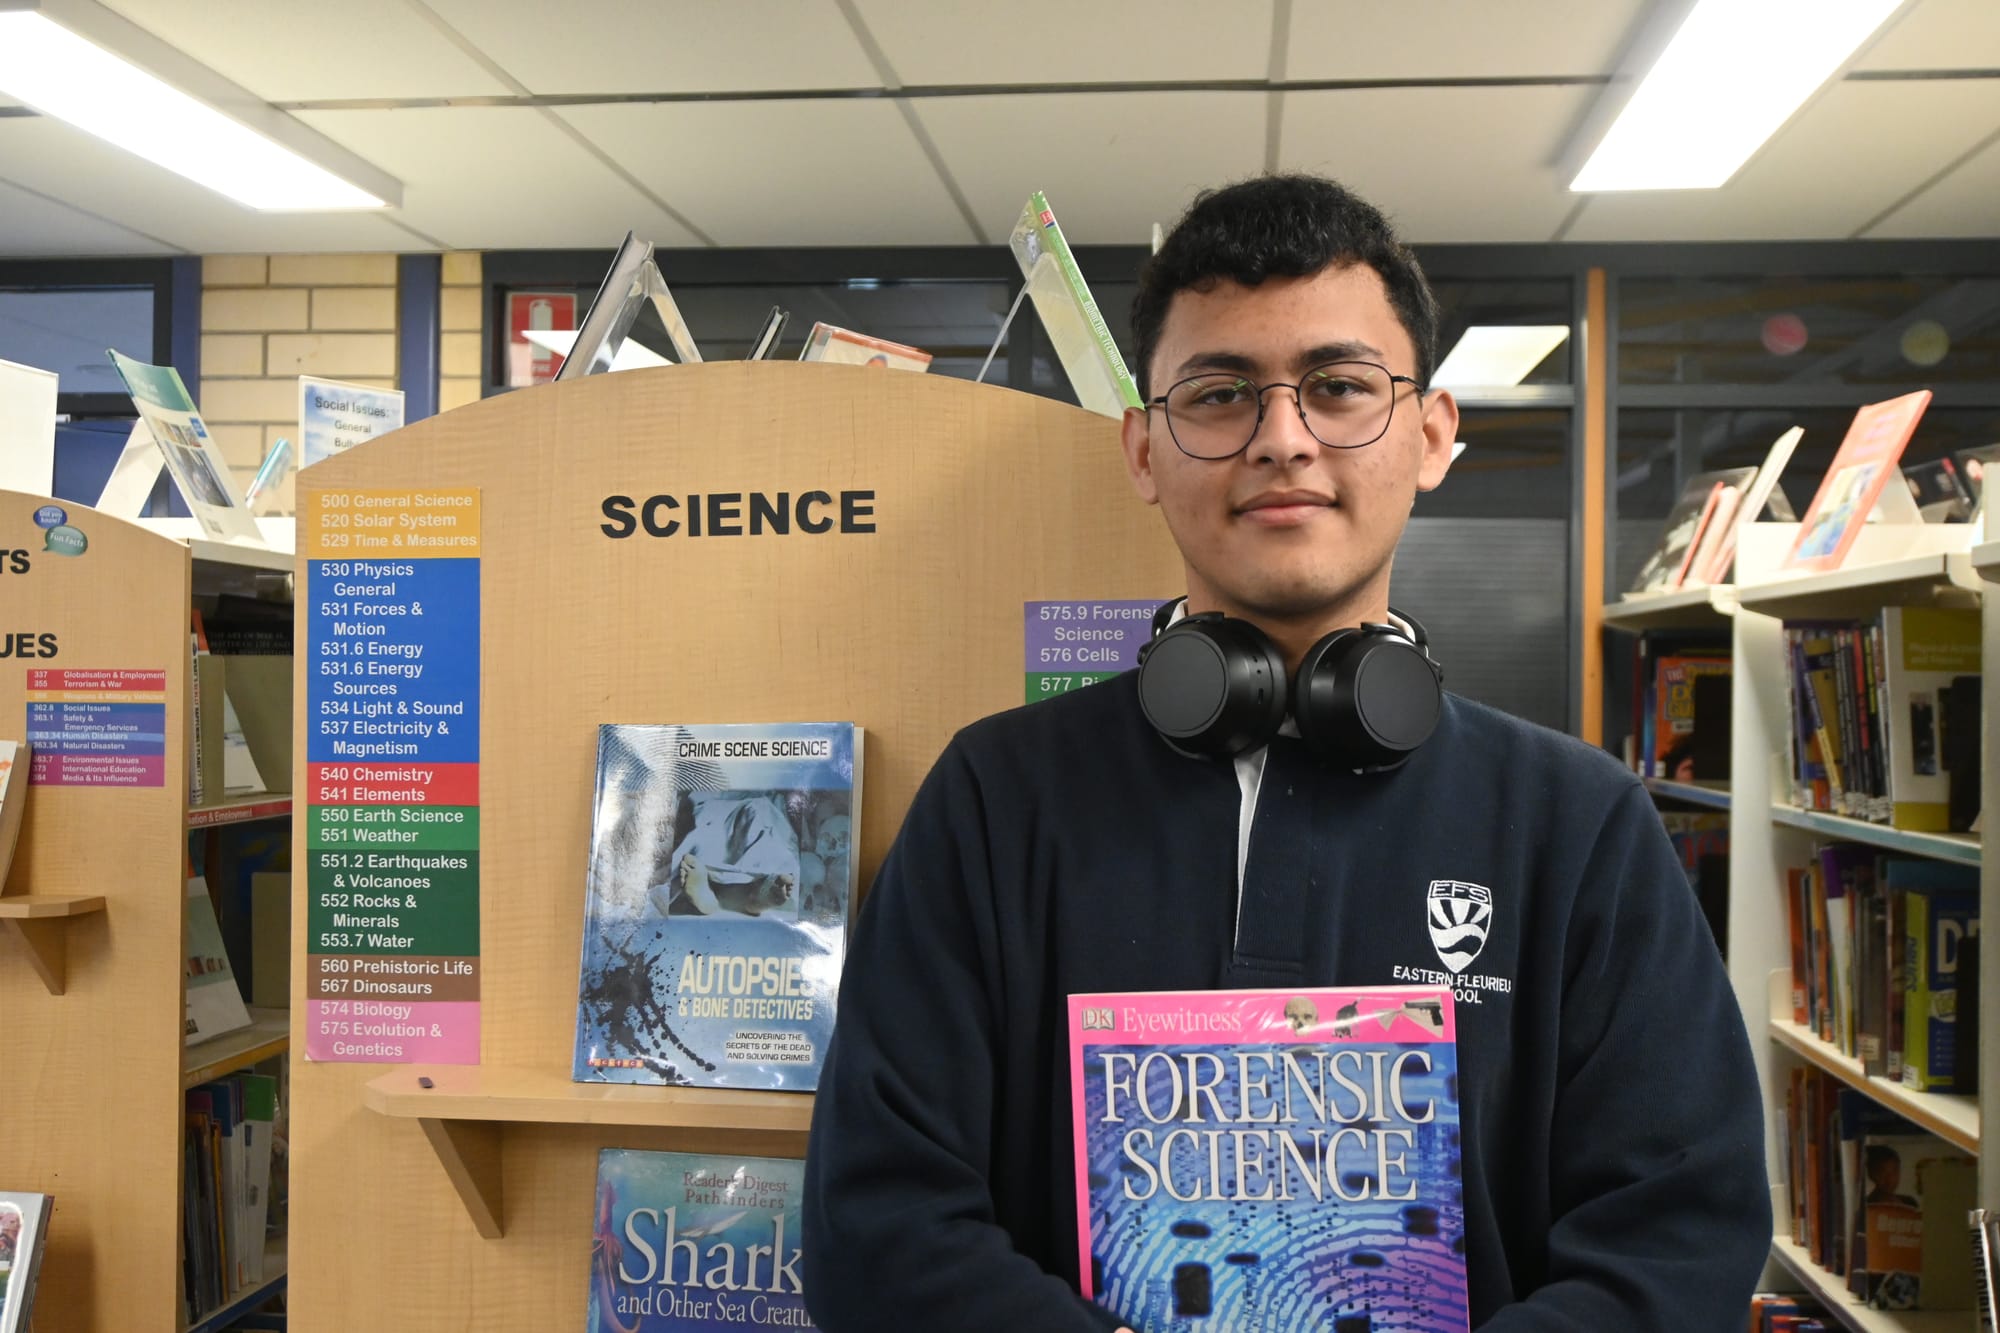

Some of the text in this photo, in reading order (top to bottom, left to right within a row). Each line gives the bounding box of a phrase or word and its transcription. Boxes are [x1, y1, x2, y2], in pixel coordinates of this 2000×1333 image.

[315, 397, 349, 412] Social
[335, 420, 371, 433] General
[321, 494, 472, 507] 500 General Science
[321, 514, 456, 529] 520 Solar System
[600, 490, 876, 538] SCIENCE
[50, 532, 84, 547] Fun Facts
[321, 534, 477, 547] 529 Time & Measures
[321, 563, 414, 580] 530 Physics
[334, 583, 395, 596] General
[321, 603, 423, 616] 531 Forces &
[1040, 605, 1157, 620] 575.9 Forensi
[334, 623, 385, 636] Motion
[1055, 627, 1124, 641] Science
[321, 642, 423, 658] 531.6 Energy
[1040, 648, 1120, 662] 576 Cells
[120, 672, 165, 680] Employment
[321, 662, 423, 678] 531.6 Energy
[333, 682, 397, 695] Sources
[1040, 677, 1072, 691] 577
[321, 702, 463, 718] 534 Light & Sound
[65, 724, 104, 732] Emergency
[321, 721, 449, 738] 537 Electricity &
[333, 741, 418, 757] Magnetism
[679, 741, 827, 757] CRIME SCENE SCIENCE
[321, 768, 433, 784] 540 Chemistry
[321, 788, 425, 801] 541 Elements
[208, 813, 214, 822] &
[215, 808, 252, 821] Employment
[321, 809, 464, 823] 550 Earth Science
[321, 829, 418, 842] 551 Weather
[321, 854, 468, 872] 551.2 Earthquakes
[334, 874, 430, 888] & Volcanoes
[1432, 882, 1488, 904] EFS
[321, 894, 417, 908] 552 Rocks &
[333, 914, 399, 928] Minerals
[321, 933, 414, 947] 553.7 Water
[321, 960, 473, 975] 560 Prehistoric Life
[1393, 966, 1511, 992] EASTERN FLEURIEU
[321, 980, 432, 994] 567 Dinosaurs
[321, 1003, 411, 1019] 574 Biology
[678, 998, 813, 1020] & BONE DETECTIVES
[321, 1023, 442, 1037] 575 Evolution &
[1085, 1008, 1242, 1039] DK Eyewitness
[736, 1032, 786, 1040] UNCOVERING
[333, 1042, 403, 1056] Genetics
[1099, 1050, 1435, 1124] FORENSIC
[1123, 1129, 1417, 1202] SCIENCE
[744, 1176, 789, 1194] Digest
[619, 1206, 803, 1295] Shark
[618, 1287, 816, 1327] and Other Sea Creatu
